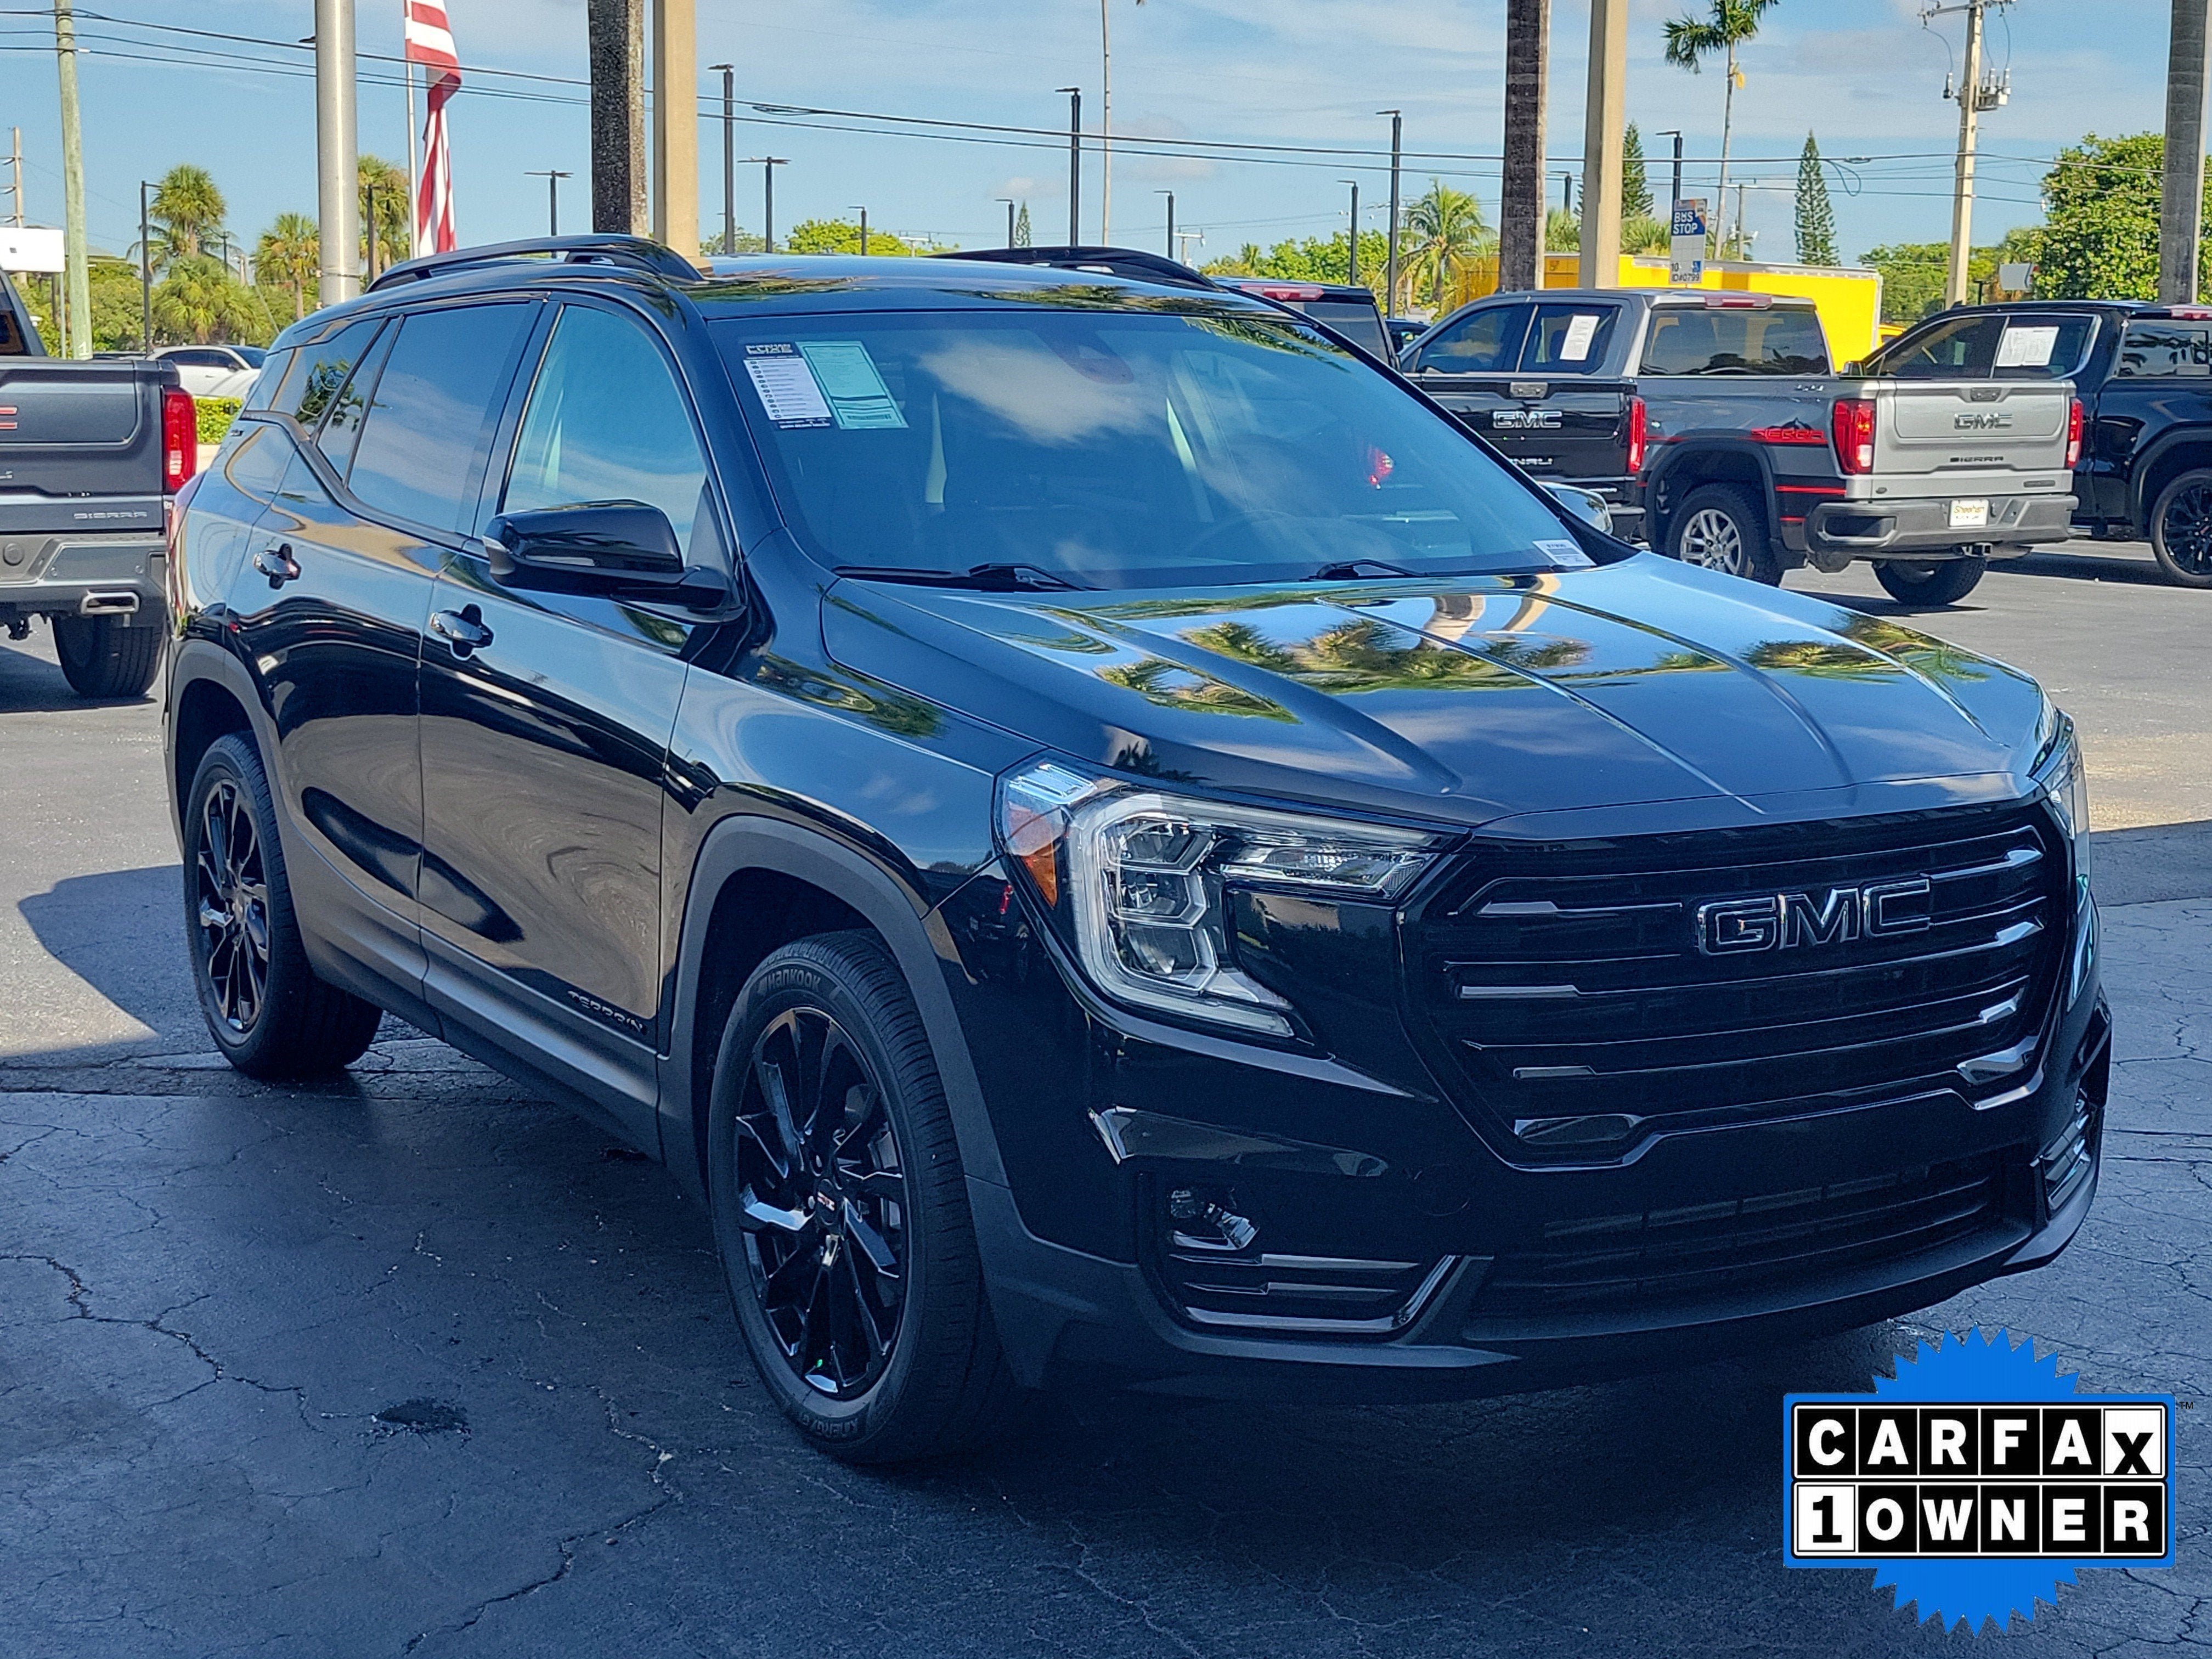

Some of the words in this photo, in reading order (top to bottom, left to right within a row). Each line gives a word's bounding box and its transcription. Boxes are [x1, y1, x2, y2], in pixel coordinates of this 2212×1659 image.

[1674, 211, 1693, 223] BUS
[1673, 223, 1698, 235] STOP
[1671, 262, 1679, 272] 10
[1493, 411, 1563, 428] GMC
[1954, 413, 2012, 430] GMC
[1697, 879, 1931, 956] GMC
